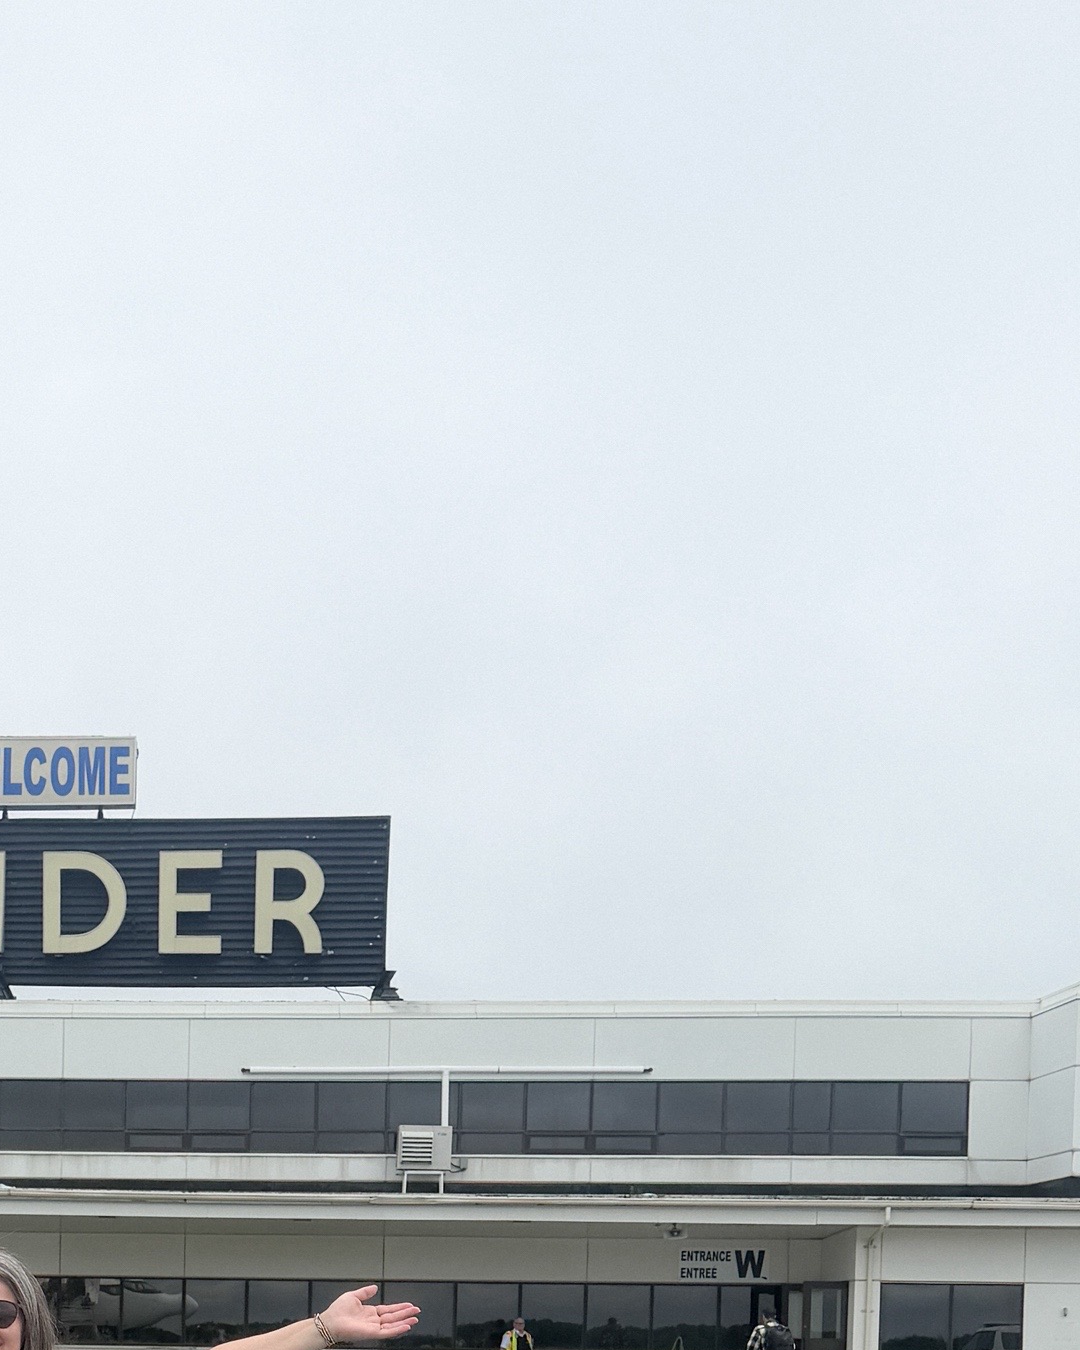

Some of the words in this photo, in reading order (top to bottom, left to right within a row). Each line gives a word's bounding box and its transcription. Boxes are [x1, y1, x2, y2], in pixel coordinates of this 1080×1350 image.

[681, 1250, 732, 1262] ENTRANCE
[734, 1249, 766, 1278] W
[680, 1267, 718, 1279] ENTREE
